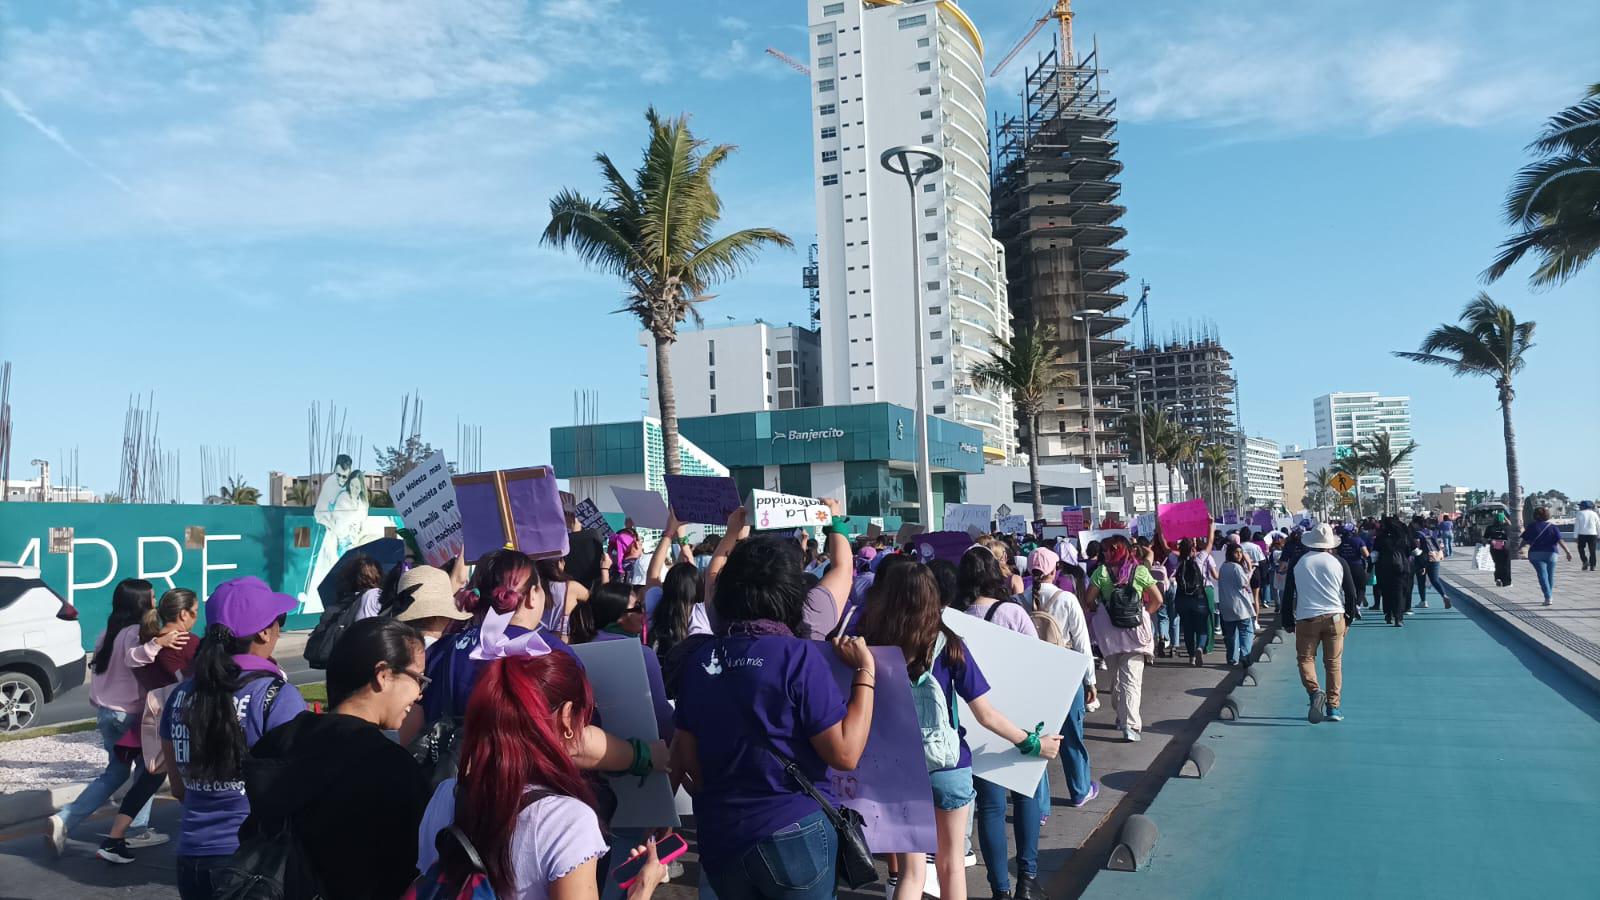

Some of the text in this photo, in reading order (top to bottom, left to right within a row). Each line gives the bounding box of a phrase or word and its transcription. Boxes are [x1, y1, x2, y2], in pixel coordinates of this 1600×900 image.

[788, 427, 844, 442] Banjercito
[411, 486, 438, 510] feminista
[437, 480, 447, 491] en
[442, 498, 455, 512] que
[786, 509, 808, 522] La
[434, 521, 462, 542] machista
